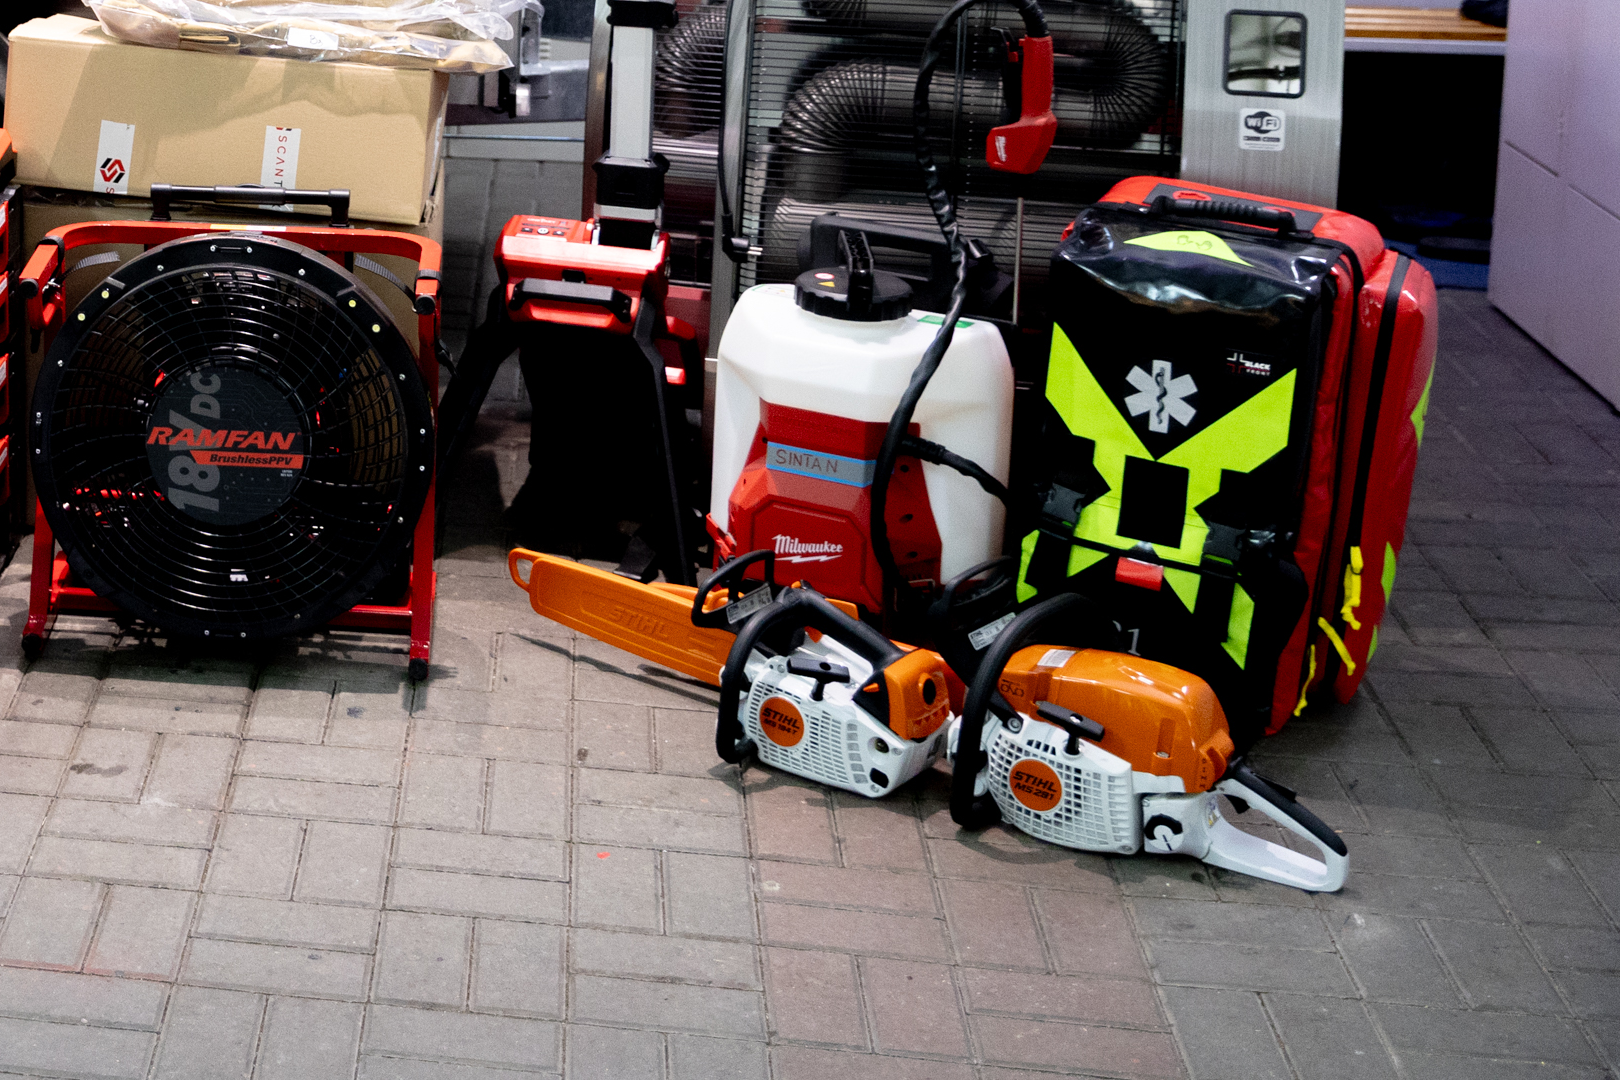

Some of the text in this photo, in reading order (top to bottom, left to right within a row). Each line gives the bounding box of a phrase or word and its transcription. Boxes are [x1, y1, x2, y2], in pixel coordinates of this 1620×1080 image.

[1244, 361, 1271, 370] BLACK
[190, 371, 221, 419] DC
[147, 426, 296, 450] RAMFAN
[210, 454, 293, 466] BrushlessPPV
[771, 533, 843, 554] Milwaukee
[609, 606, 668, 637] STIHL
[762, 707, 800, 730] STIHL
[1012, 770, 1057, 792] STIHL
[1014, 782, 1033, 793] MS
